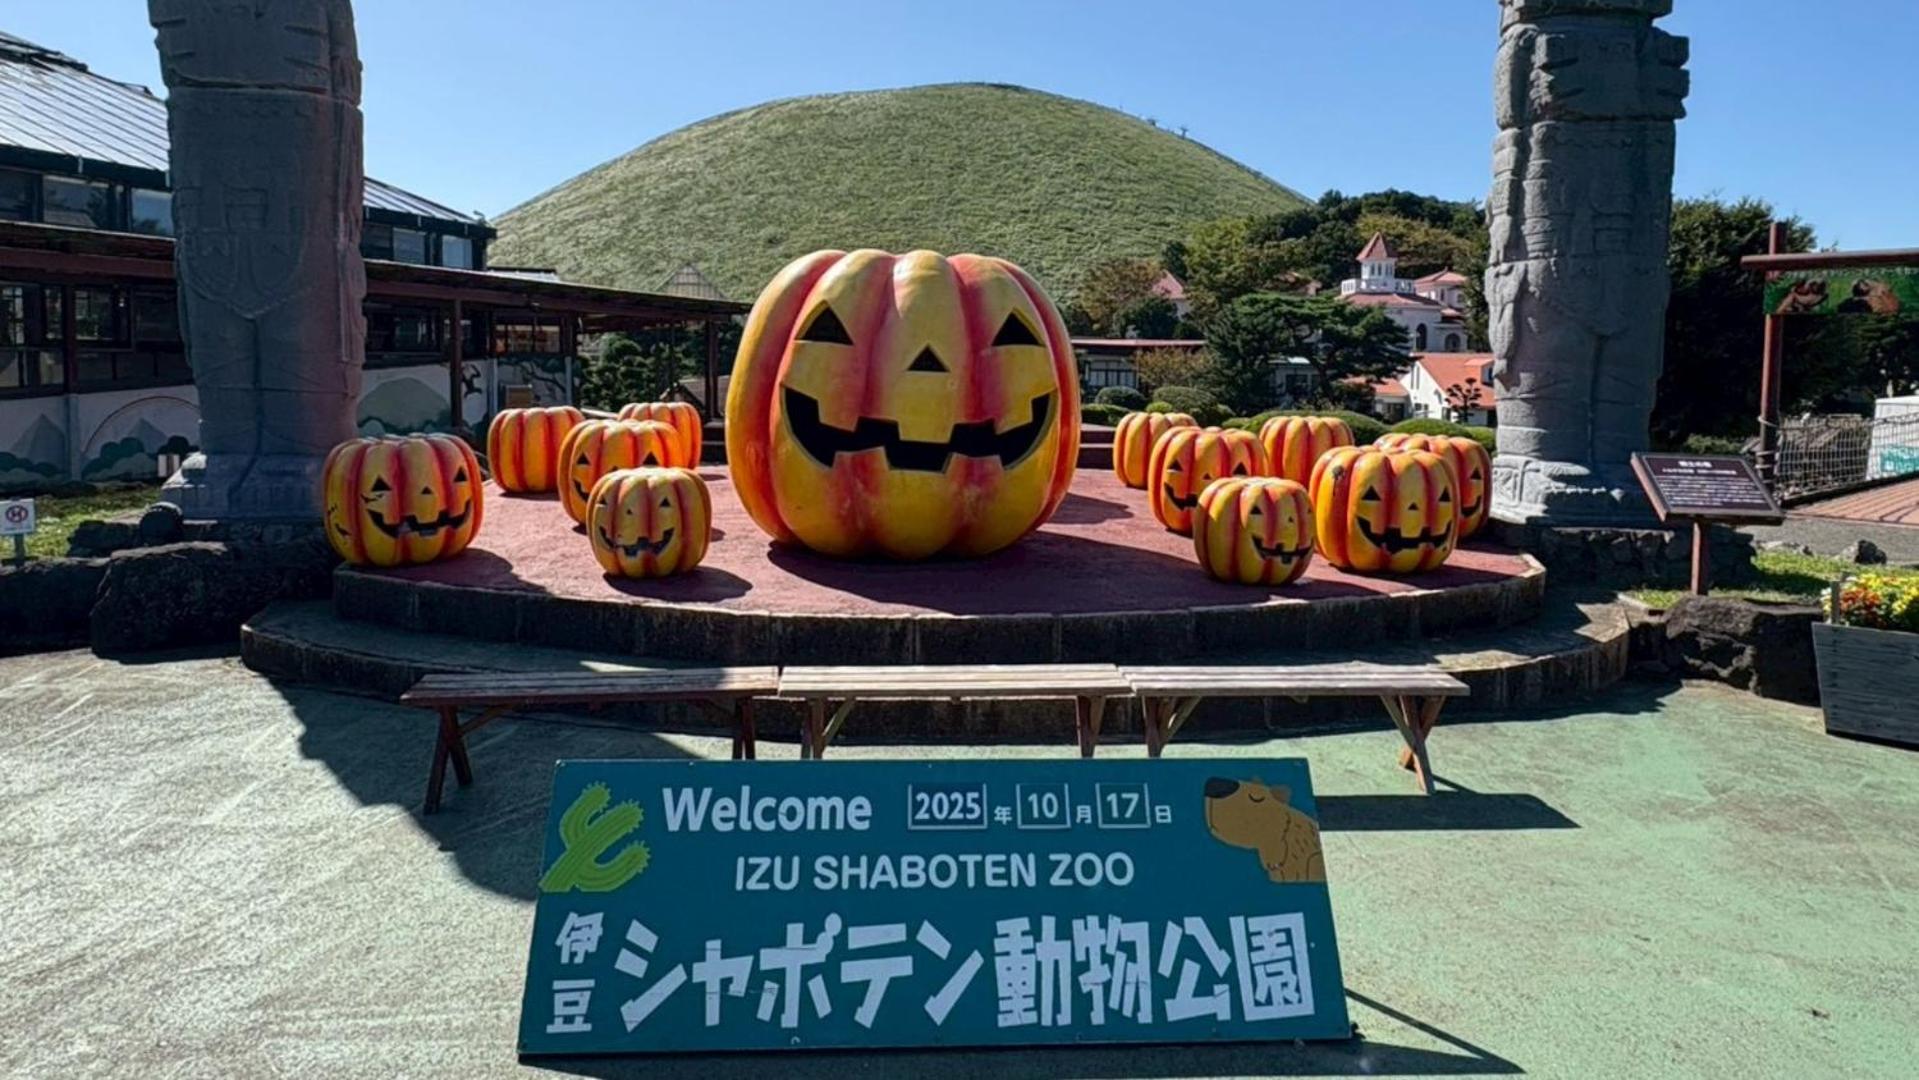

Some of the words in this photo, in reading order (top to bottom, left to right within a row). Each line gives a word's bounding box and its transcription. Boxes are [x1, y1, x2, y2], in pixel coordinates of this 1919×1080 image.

[661, 784, 873, 832] Welcome
[735, 855, 800, 891] IZU
[813, 852, 1037, 890] SHABOTEN
[1048, 851, 1135, 887] ZOO
